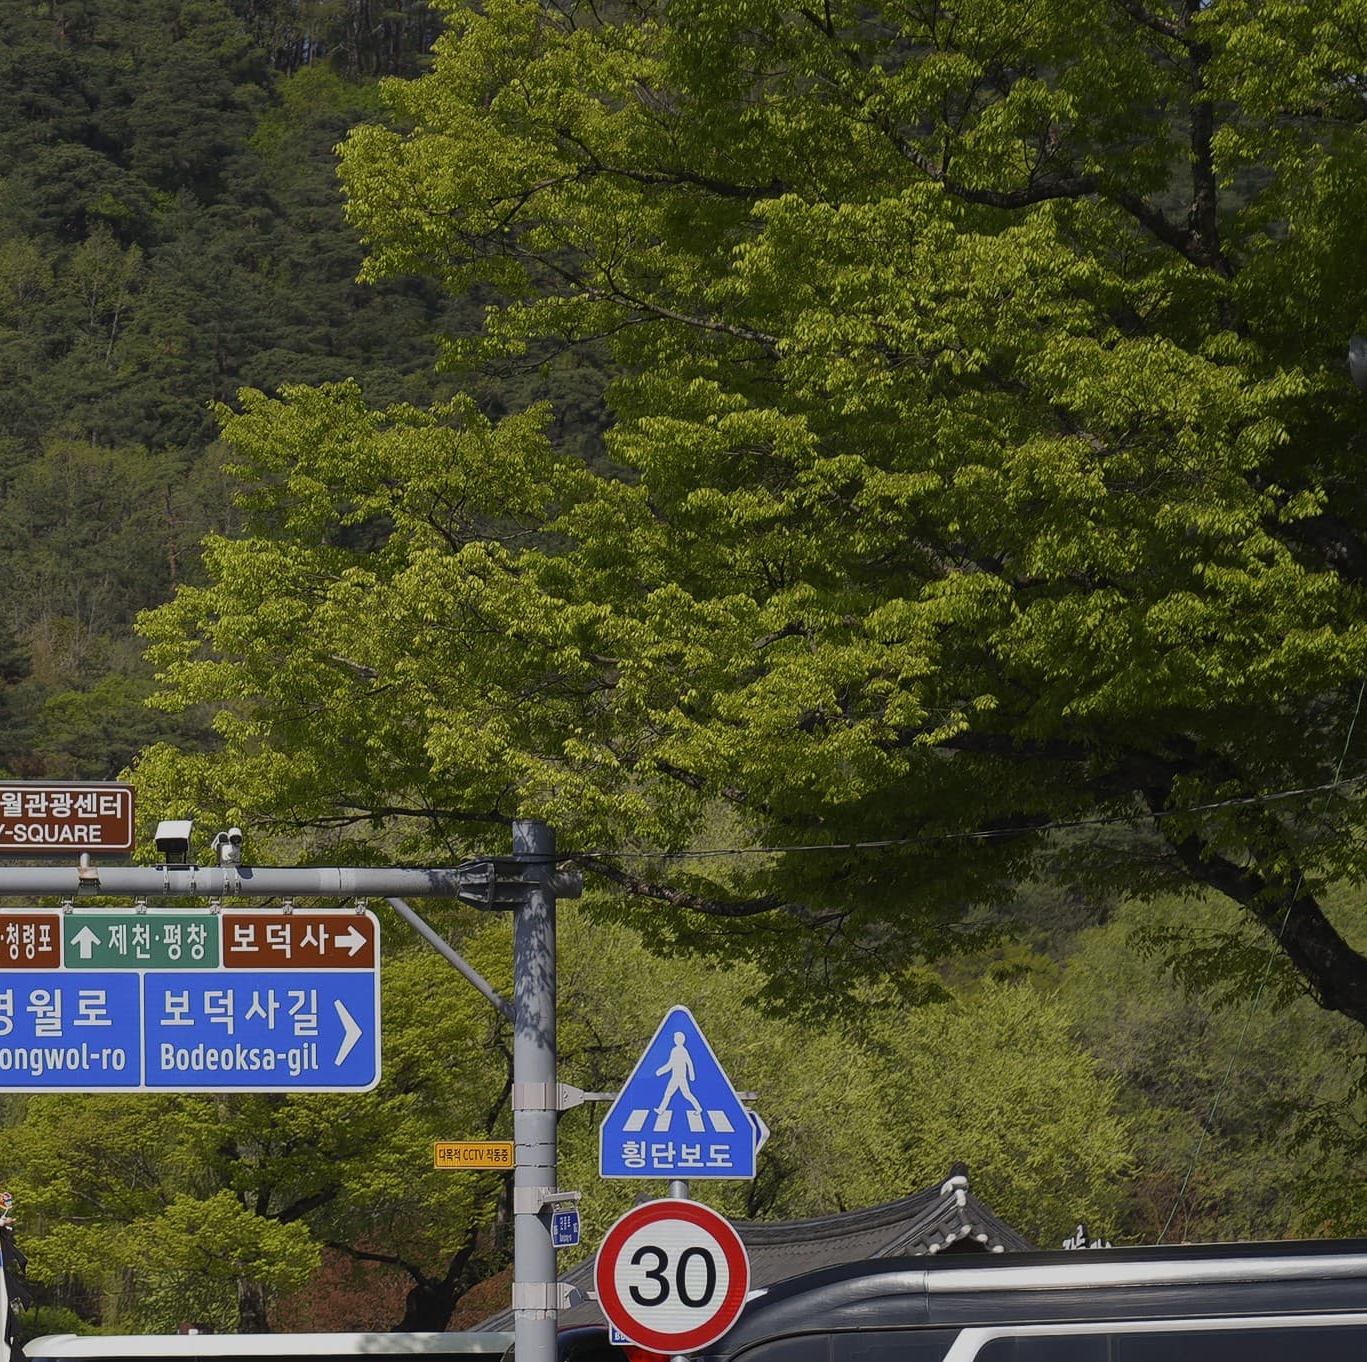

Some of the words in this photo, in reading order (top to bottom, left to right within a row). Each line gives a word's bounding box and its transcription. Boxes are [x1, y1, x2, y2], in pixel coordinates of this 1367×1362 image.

[231, 924, 329, 959] 보덕사
[160, 988, 319, 1036] 보덕사길
[160, 1042, 319, 1077] Bodeoksa-gil
[439, 1148, 460, 1161] 다목적
[463, 1149, 484, 1160] CCTV
[486, 1148, 508, 1162] 작동중
[621, 1140, 733, 1169] 횡단보도
[628, 1245, 717, 1307] 30
